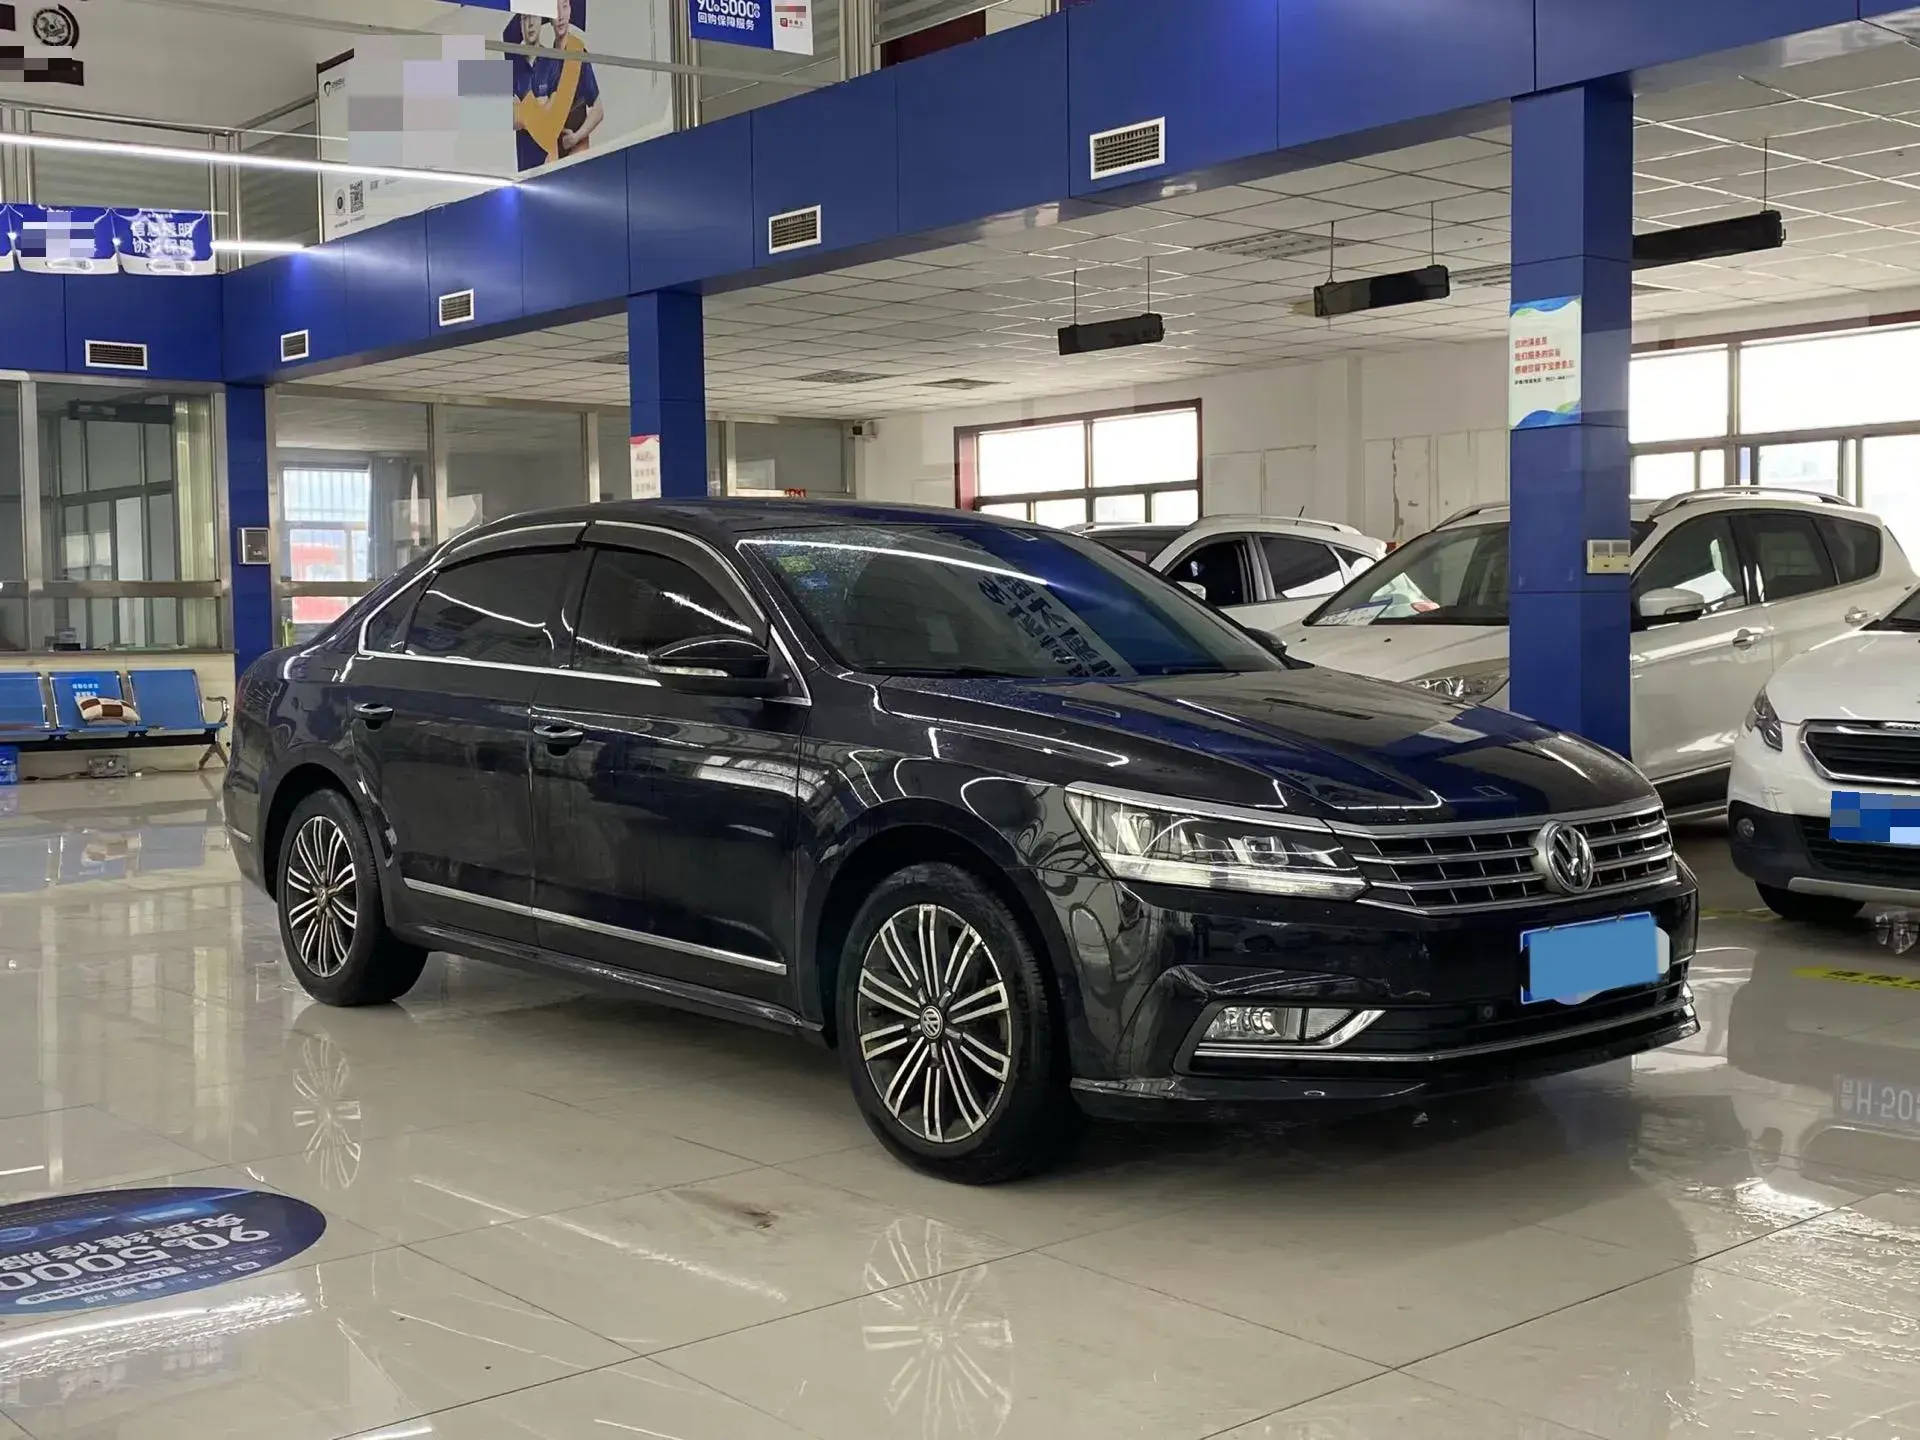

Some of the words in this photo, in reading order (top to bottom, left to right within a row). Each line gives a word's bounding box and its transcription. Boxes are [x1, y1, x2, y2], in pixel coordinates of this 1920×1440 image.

[698, 12, 755, 31] 回购保障服务
